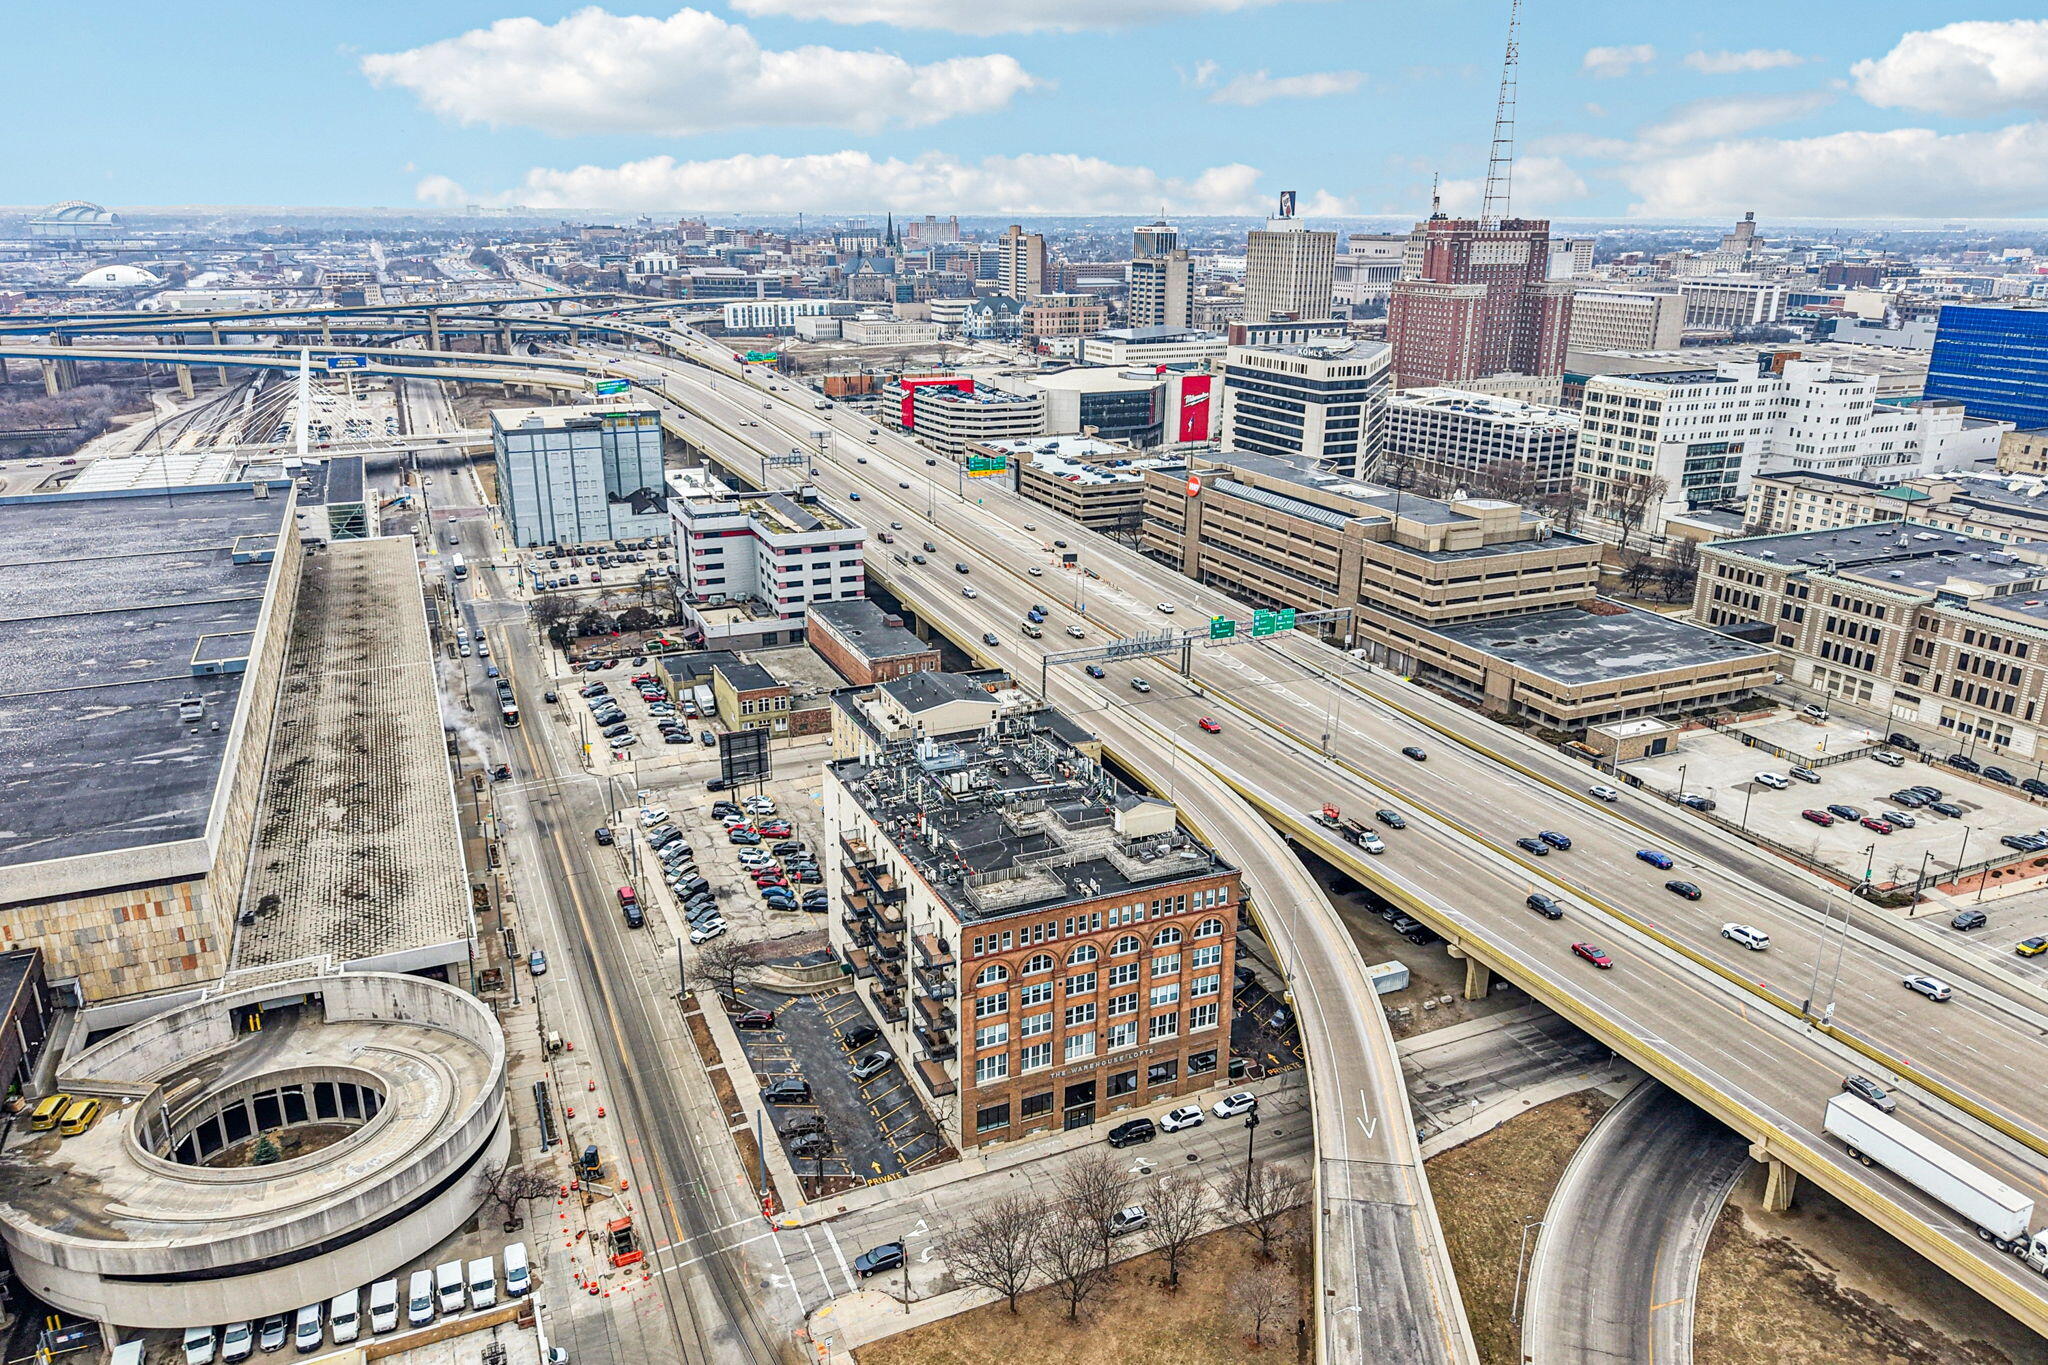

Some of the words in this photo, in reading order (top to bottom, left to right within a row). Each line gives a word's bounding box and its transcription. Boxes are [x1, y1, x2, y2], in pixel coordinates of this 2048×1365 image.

[1050, 1071, 1066, 1079] THE
[1071, 1056, 1124, 1073] WAREHOUSE
[1128, 1048, 1154, 1059] LOFTS
[1267, 1062, 1302, 1076] PRIVATE
[866, 1172, 904, 1187] PRIVATE
